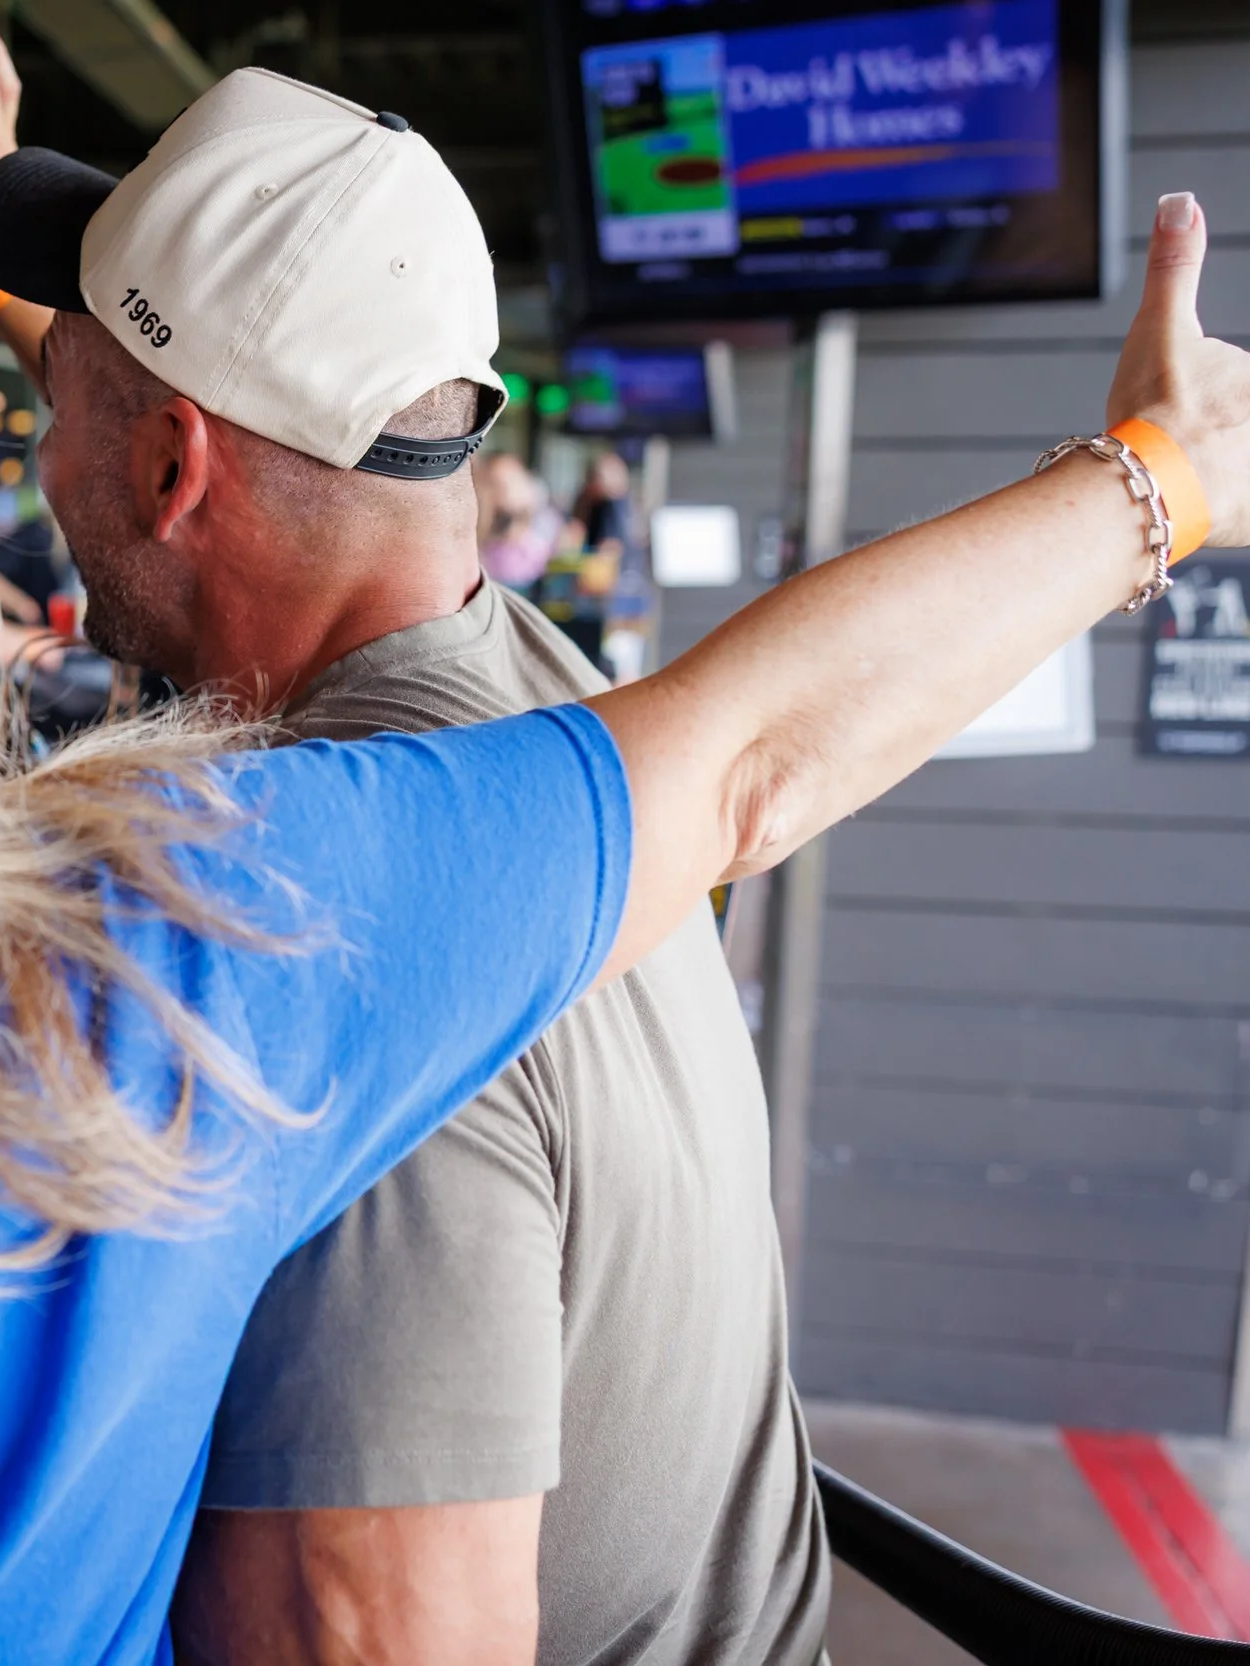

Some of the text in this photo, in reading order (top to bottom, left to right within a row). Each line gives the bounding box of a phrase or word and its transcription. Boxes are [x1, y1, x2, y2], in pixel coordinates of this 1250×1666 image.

[727, 51, 854, 110] David
[856, 36, 1049, 96] Weekley
[807, 102, 962, 149] Homes
[119, 288, 172, 348] 1969
